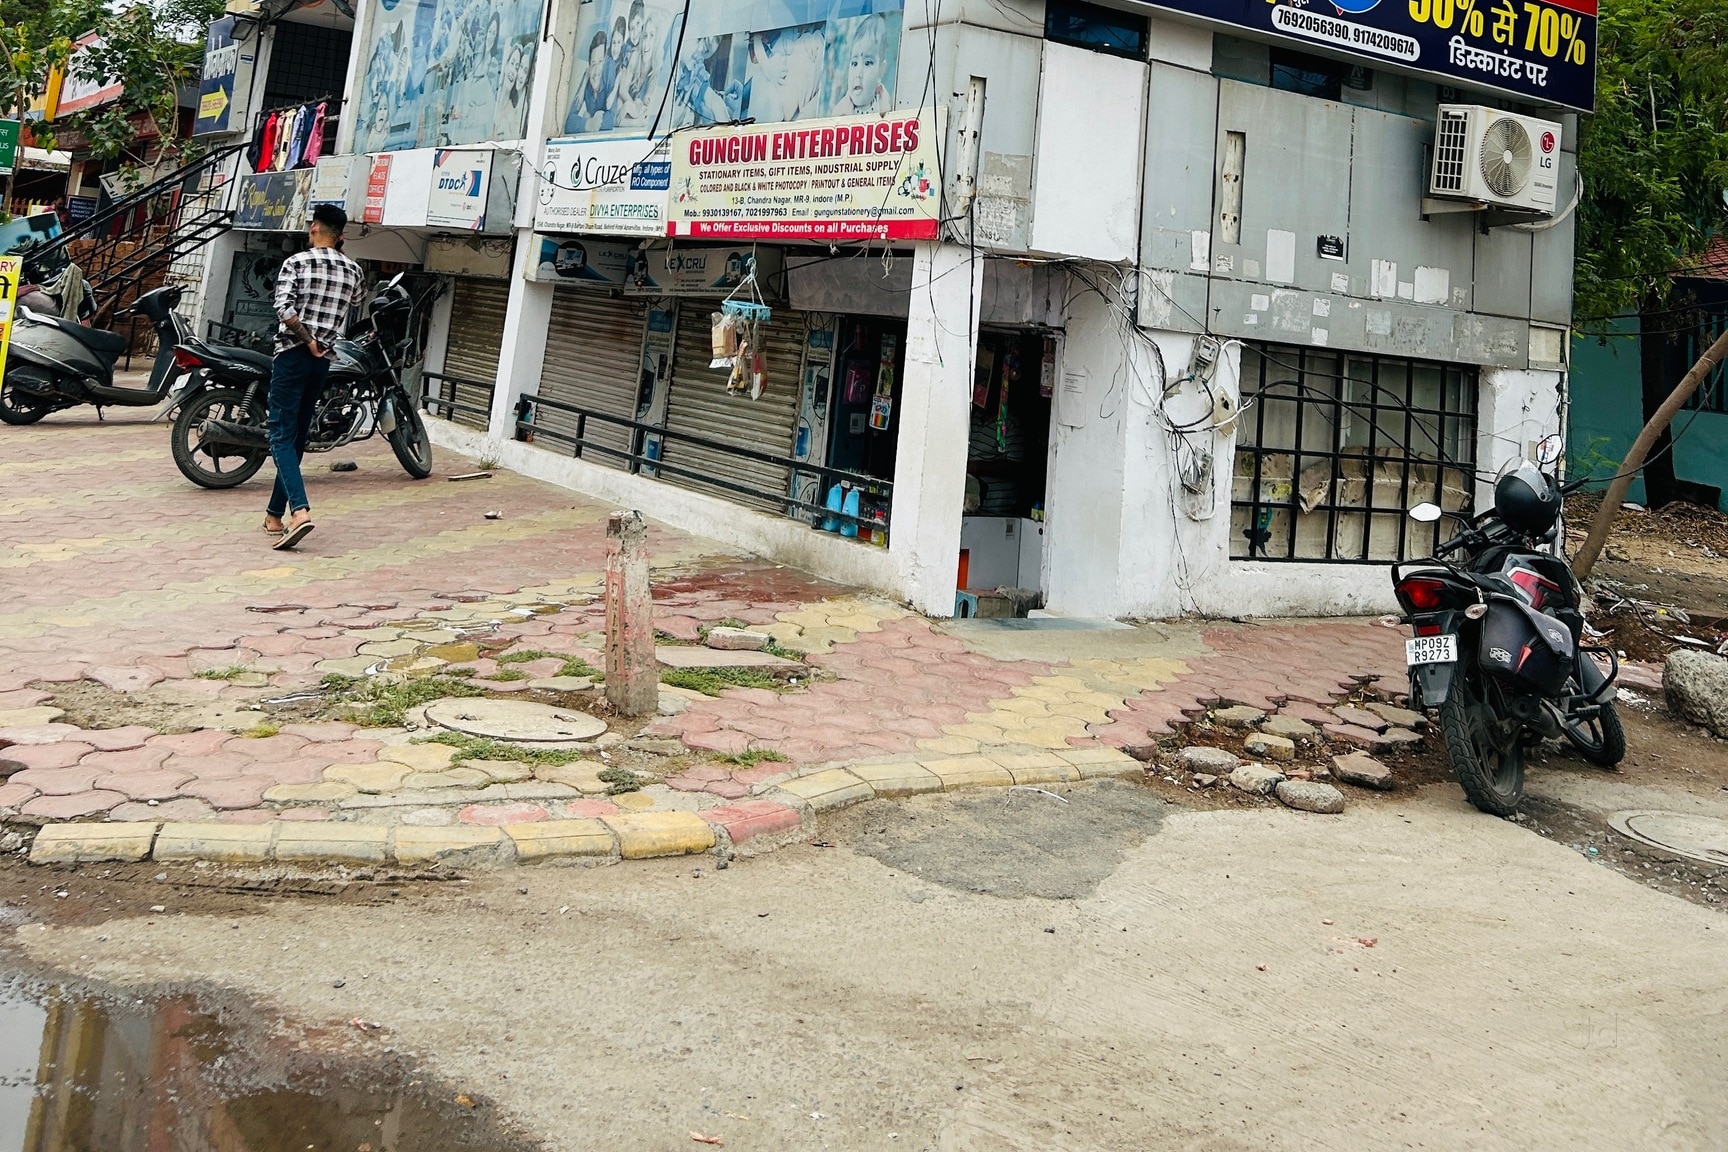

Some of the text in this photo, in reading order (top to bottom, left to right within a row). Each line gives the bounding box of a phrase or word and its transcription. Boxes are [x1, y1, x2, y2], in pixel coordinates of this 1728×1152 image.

[1278, 8, 1415, 56] 7692056390, 9174209674
[1491, 0, 1518, 47] से
[1523, 1, 1587, 66] 70%
[1448, 34, 1549, 88] डिस्काउंट पर
[689, 119, 920, 167] GUNGUN ENTERPRISES
[699, 159, 900, 181] STATIONARY ITEMS, GIFT ITEMS, INDUSTRIAL SUPPLY
[1540, 156, 1551, 169] LG
[585, 157, 628, 185] Cruze
[700, 176, 896, 193] COLORED AND BLACK WHITE PHOTOCOPY PRINTOUT GENERAL ITEMS
[747, 195, 772, 205] Chandra
[812, 194, 833, 204] Indore
[590, 204, 659, 219] DIVYA ENTERPRISES
[702, 208, 744, 219] 9930139167,
[745, 207, 788, 217] 7021997963
[792, 208, 809, 217] Email
[699, 222, 889, 234] We Offer Exclusive Discounts on all Purchases
[1415, 637, 1449, 650] MP09Z
[1415, 649, 1450, 662] R9273
